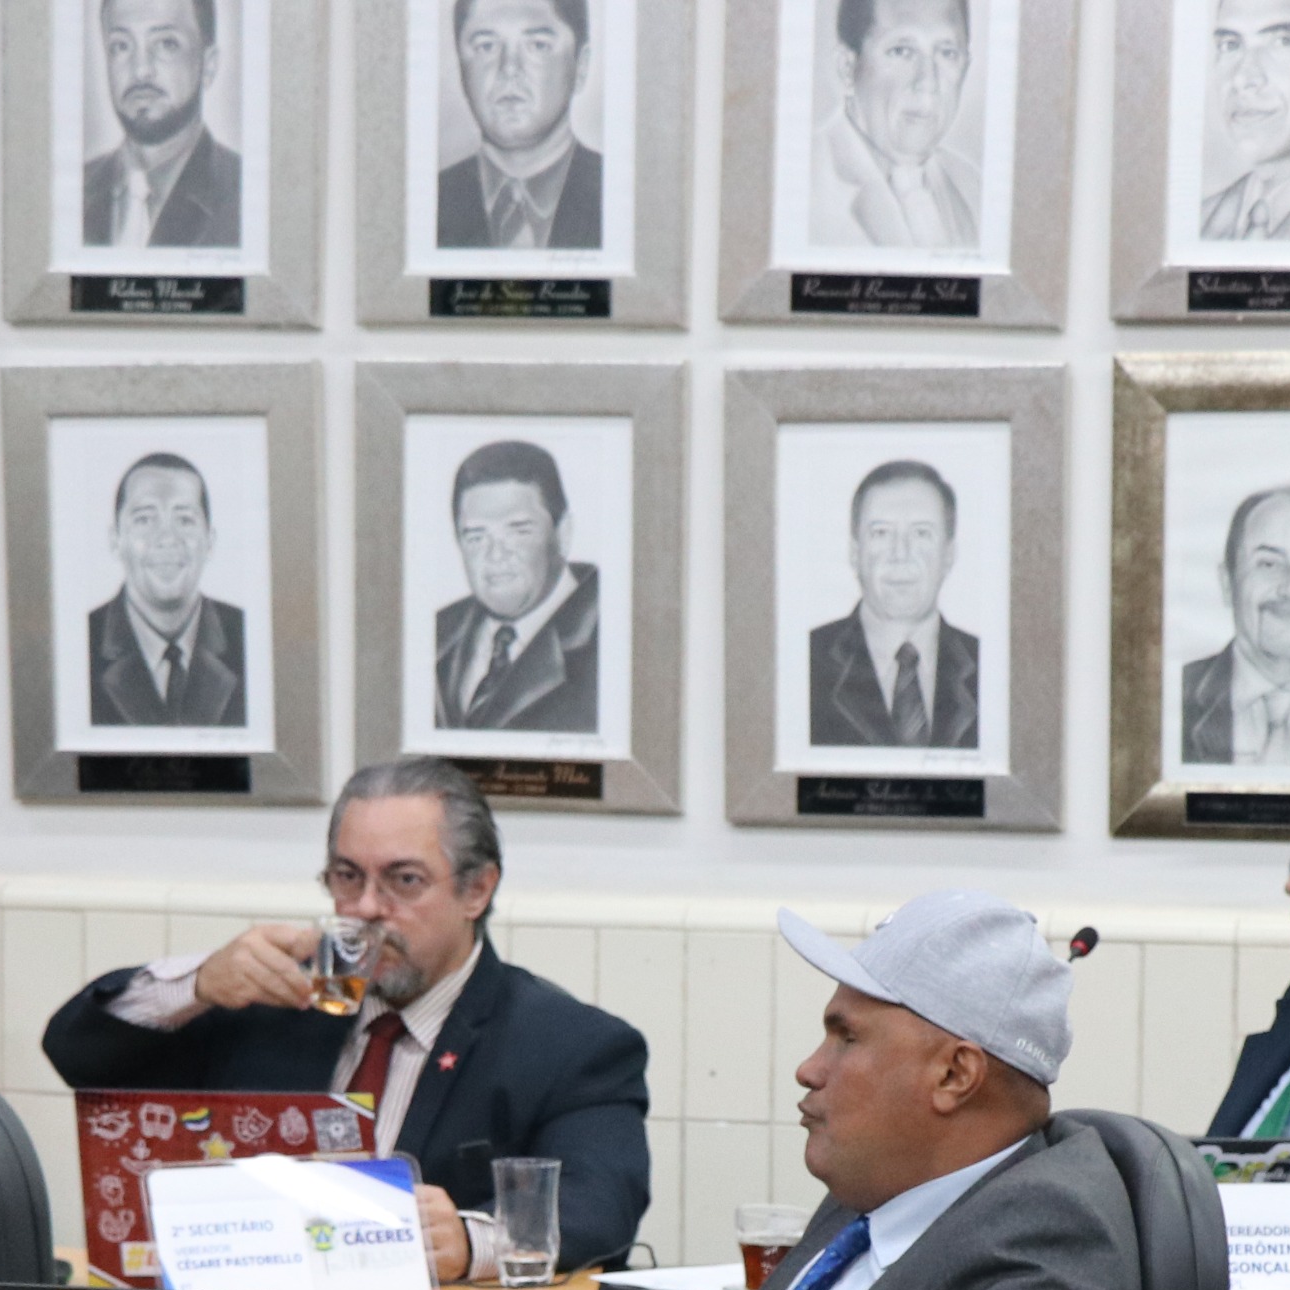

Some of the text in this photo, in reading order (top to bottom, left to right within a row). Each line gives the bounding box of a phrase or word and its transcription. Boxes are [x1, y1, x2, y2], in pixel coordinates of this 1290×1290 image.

[189, 1220, 274, 1237] SECRETÁRIO
[343, 1229, 414, 1245] CÁCERES
[177, 1254, 303, 1271] CÉSARE PASTORELLO
